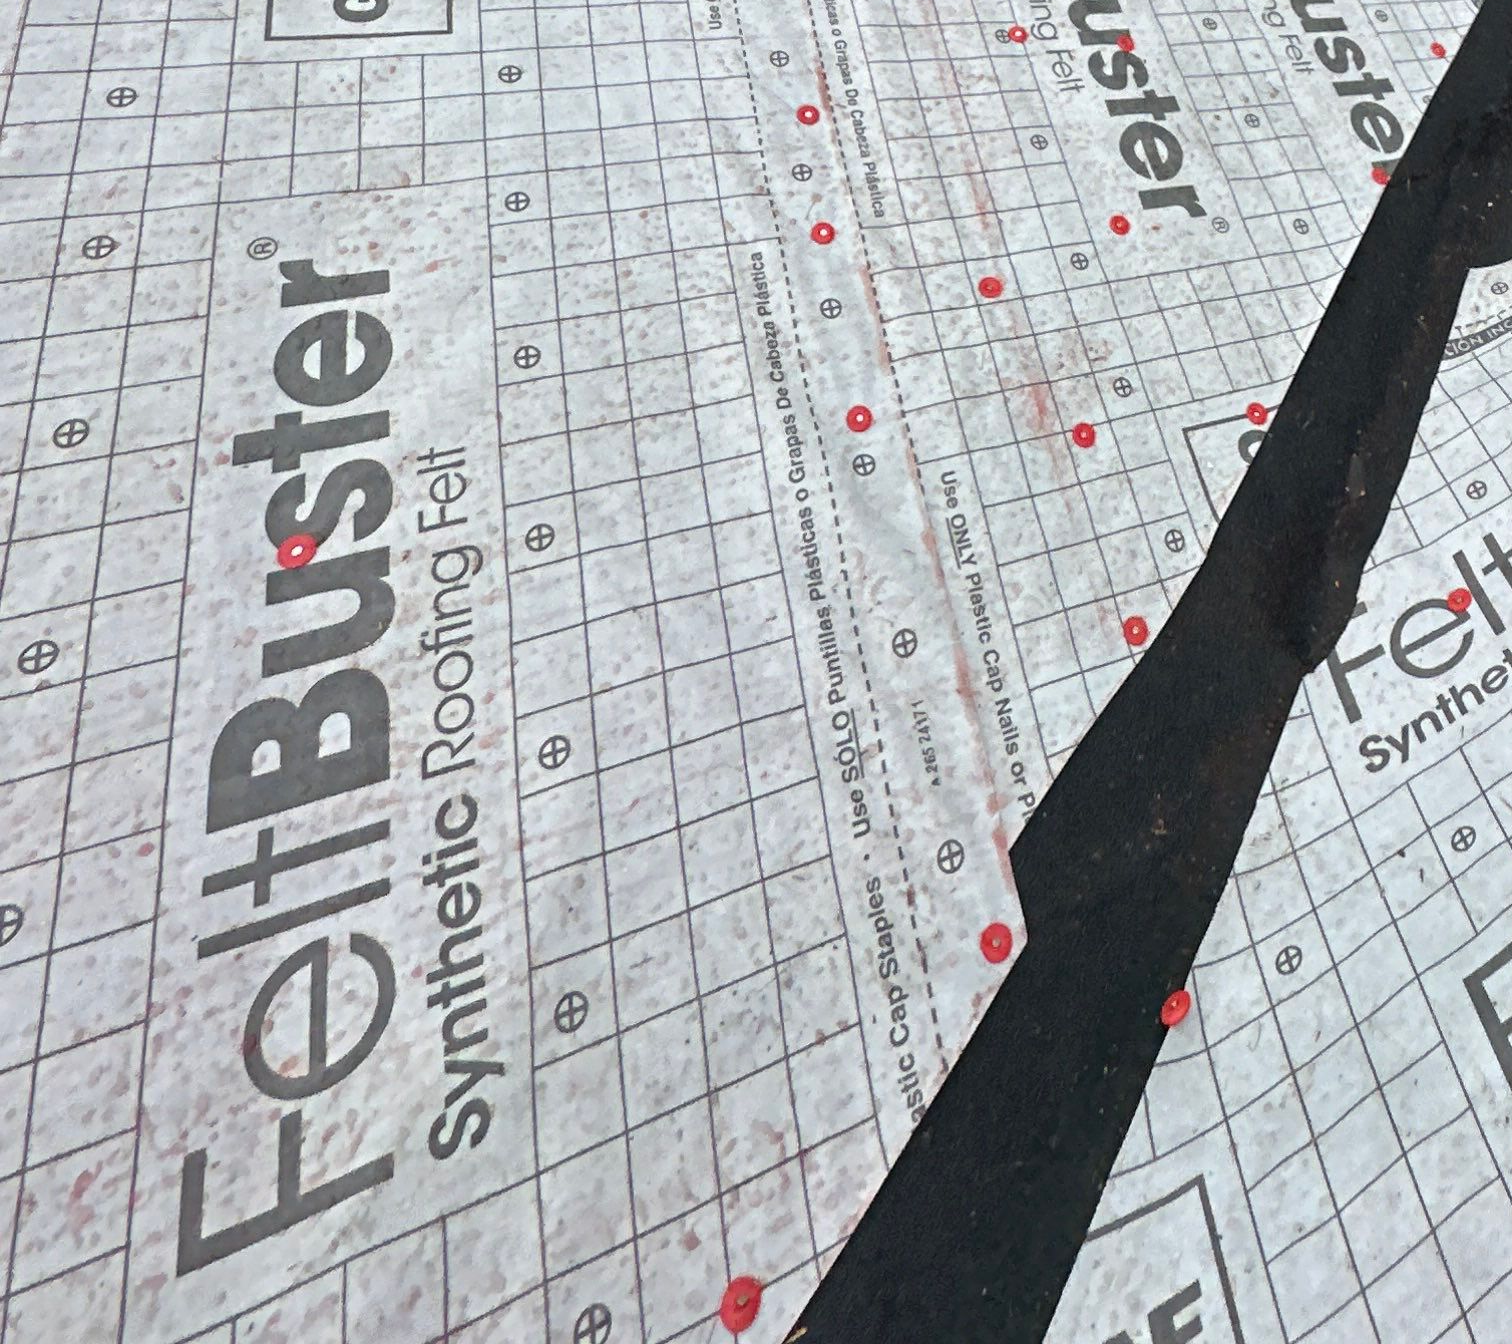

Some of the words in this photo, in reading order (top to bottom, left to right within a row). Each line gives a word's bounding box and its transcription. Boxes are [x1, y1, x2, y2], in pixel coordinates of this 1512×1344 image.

[708, 5, 722, 31] Use
[1046, 48, 1087, 95] Felt
[1276, 28, 1315, 75] Felt
[850, 109, 872, 160] Cabeza
[762, 318, 786, 377] Cabeza
[775, 379, 793, 408] De
[779, 410, 806, 484] Grapas
[416, 443, 473, 535] Felt
[940, 471, 958, 509] Use
[946, 513, 977, 569] ONLY
[966, 572, 990, 643] Plastic
[421, 535, 485, 776] Roofing
[816, 604, 848, 706] Puntillas
[982, 649, 1002, 693] Cap
[994, 699, 1018, 756] Nails
[1010, 758, 1026, 780] or
[850, 789, 871, 839] Use
[866, 874, 900, 982] Staples
[427, 786, 507, 1163] Synthetic
[888, 984, 911, 1047] Cap
